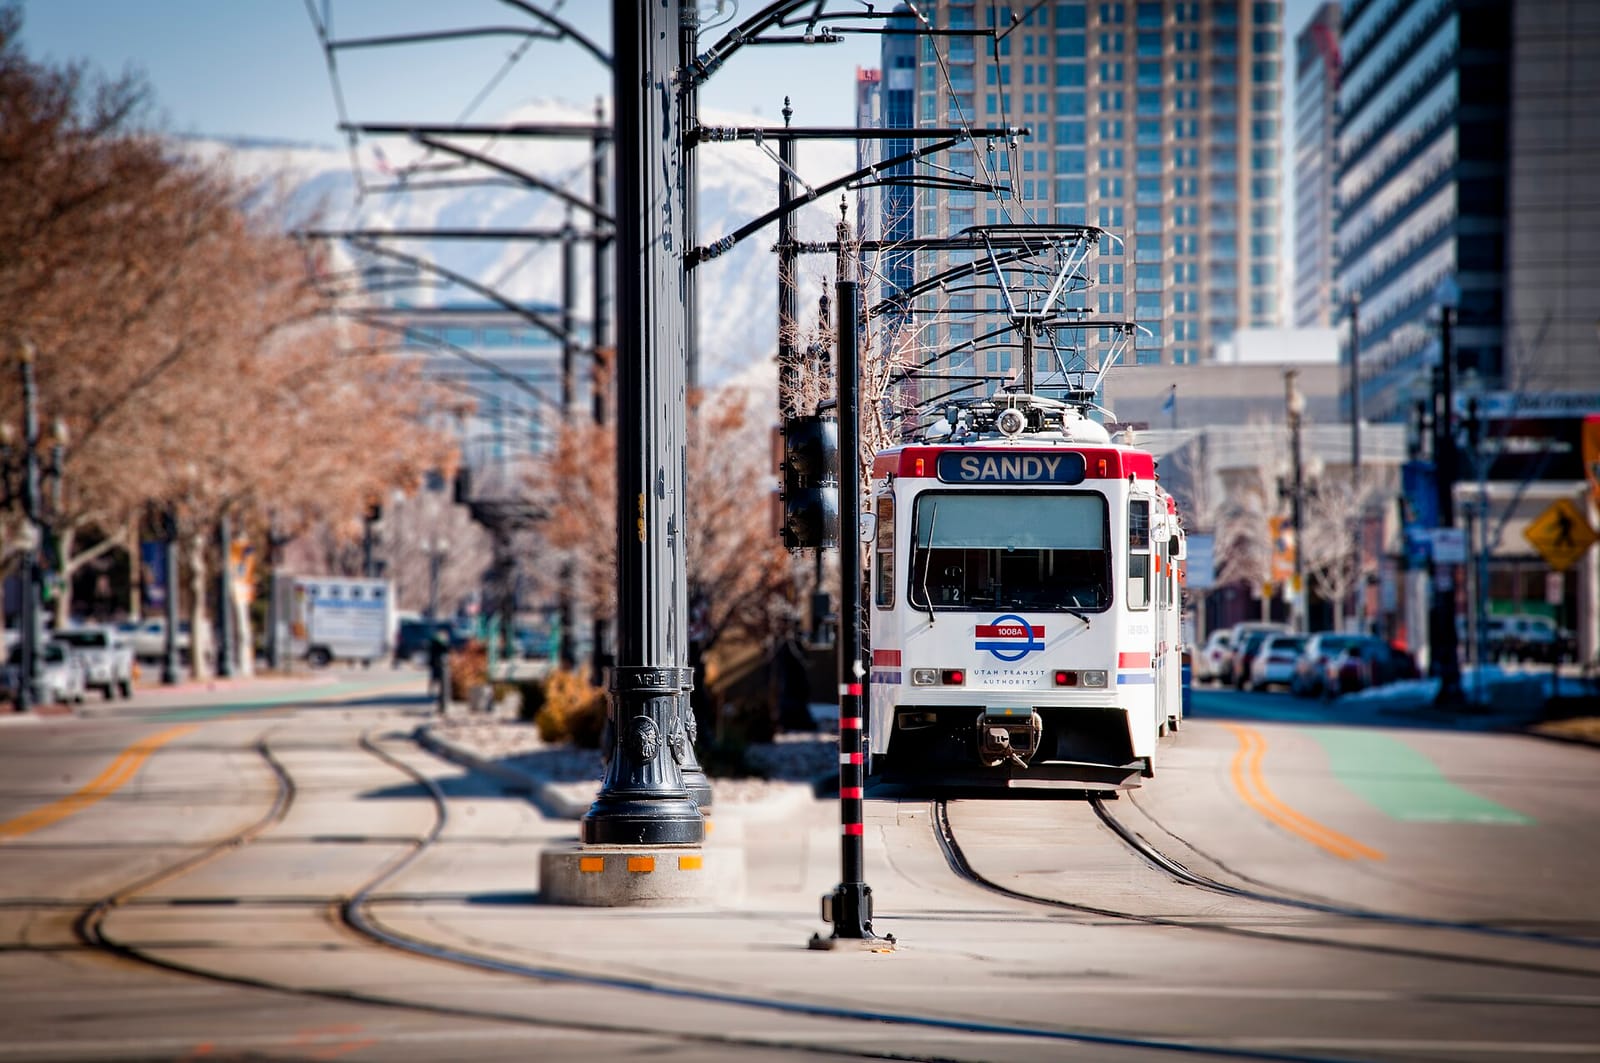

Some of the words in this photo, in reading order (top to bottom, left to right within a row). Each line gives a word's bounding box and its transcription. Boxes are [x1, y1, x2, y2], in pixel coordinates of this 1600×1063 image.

[960, 456, 1062, 480] SANDY
[953, 588, 960, 601] 2
[998, 628, 1023, 636] 1008A
